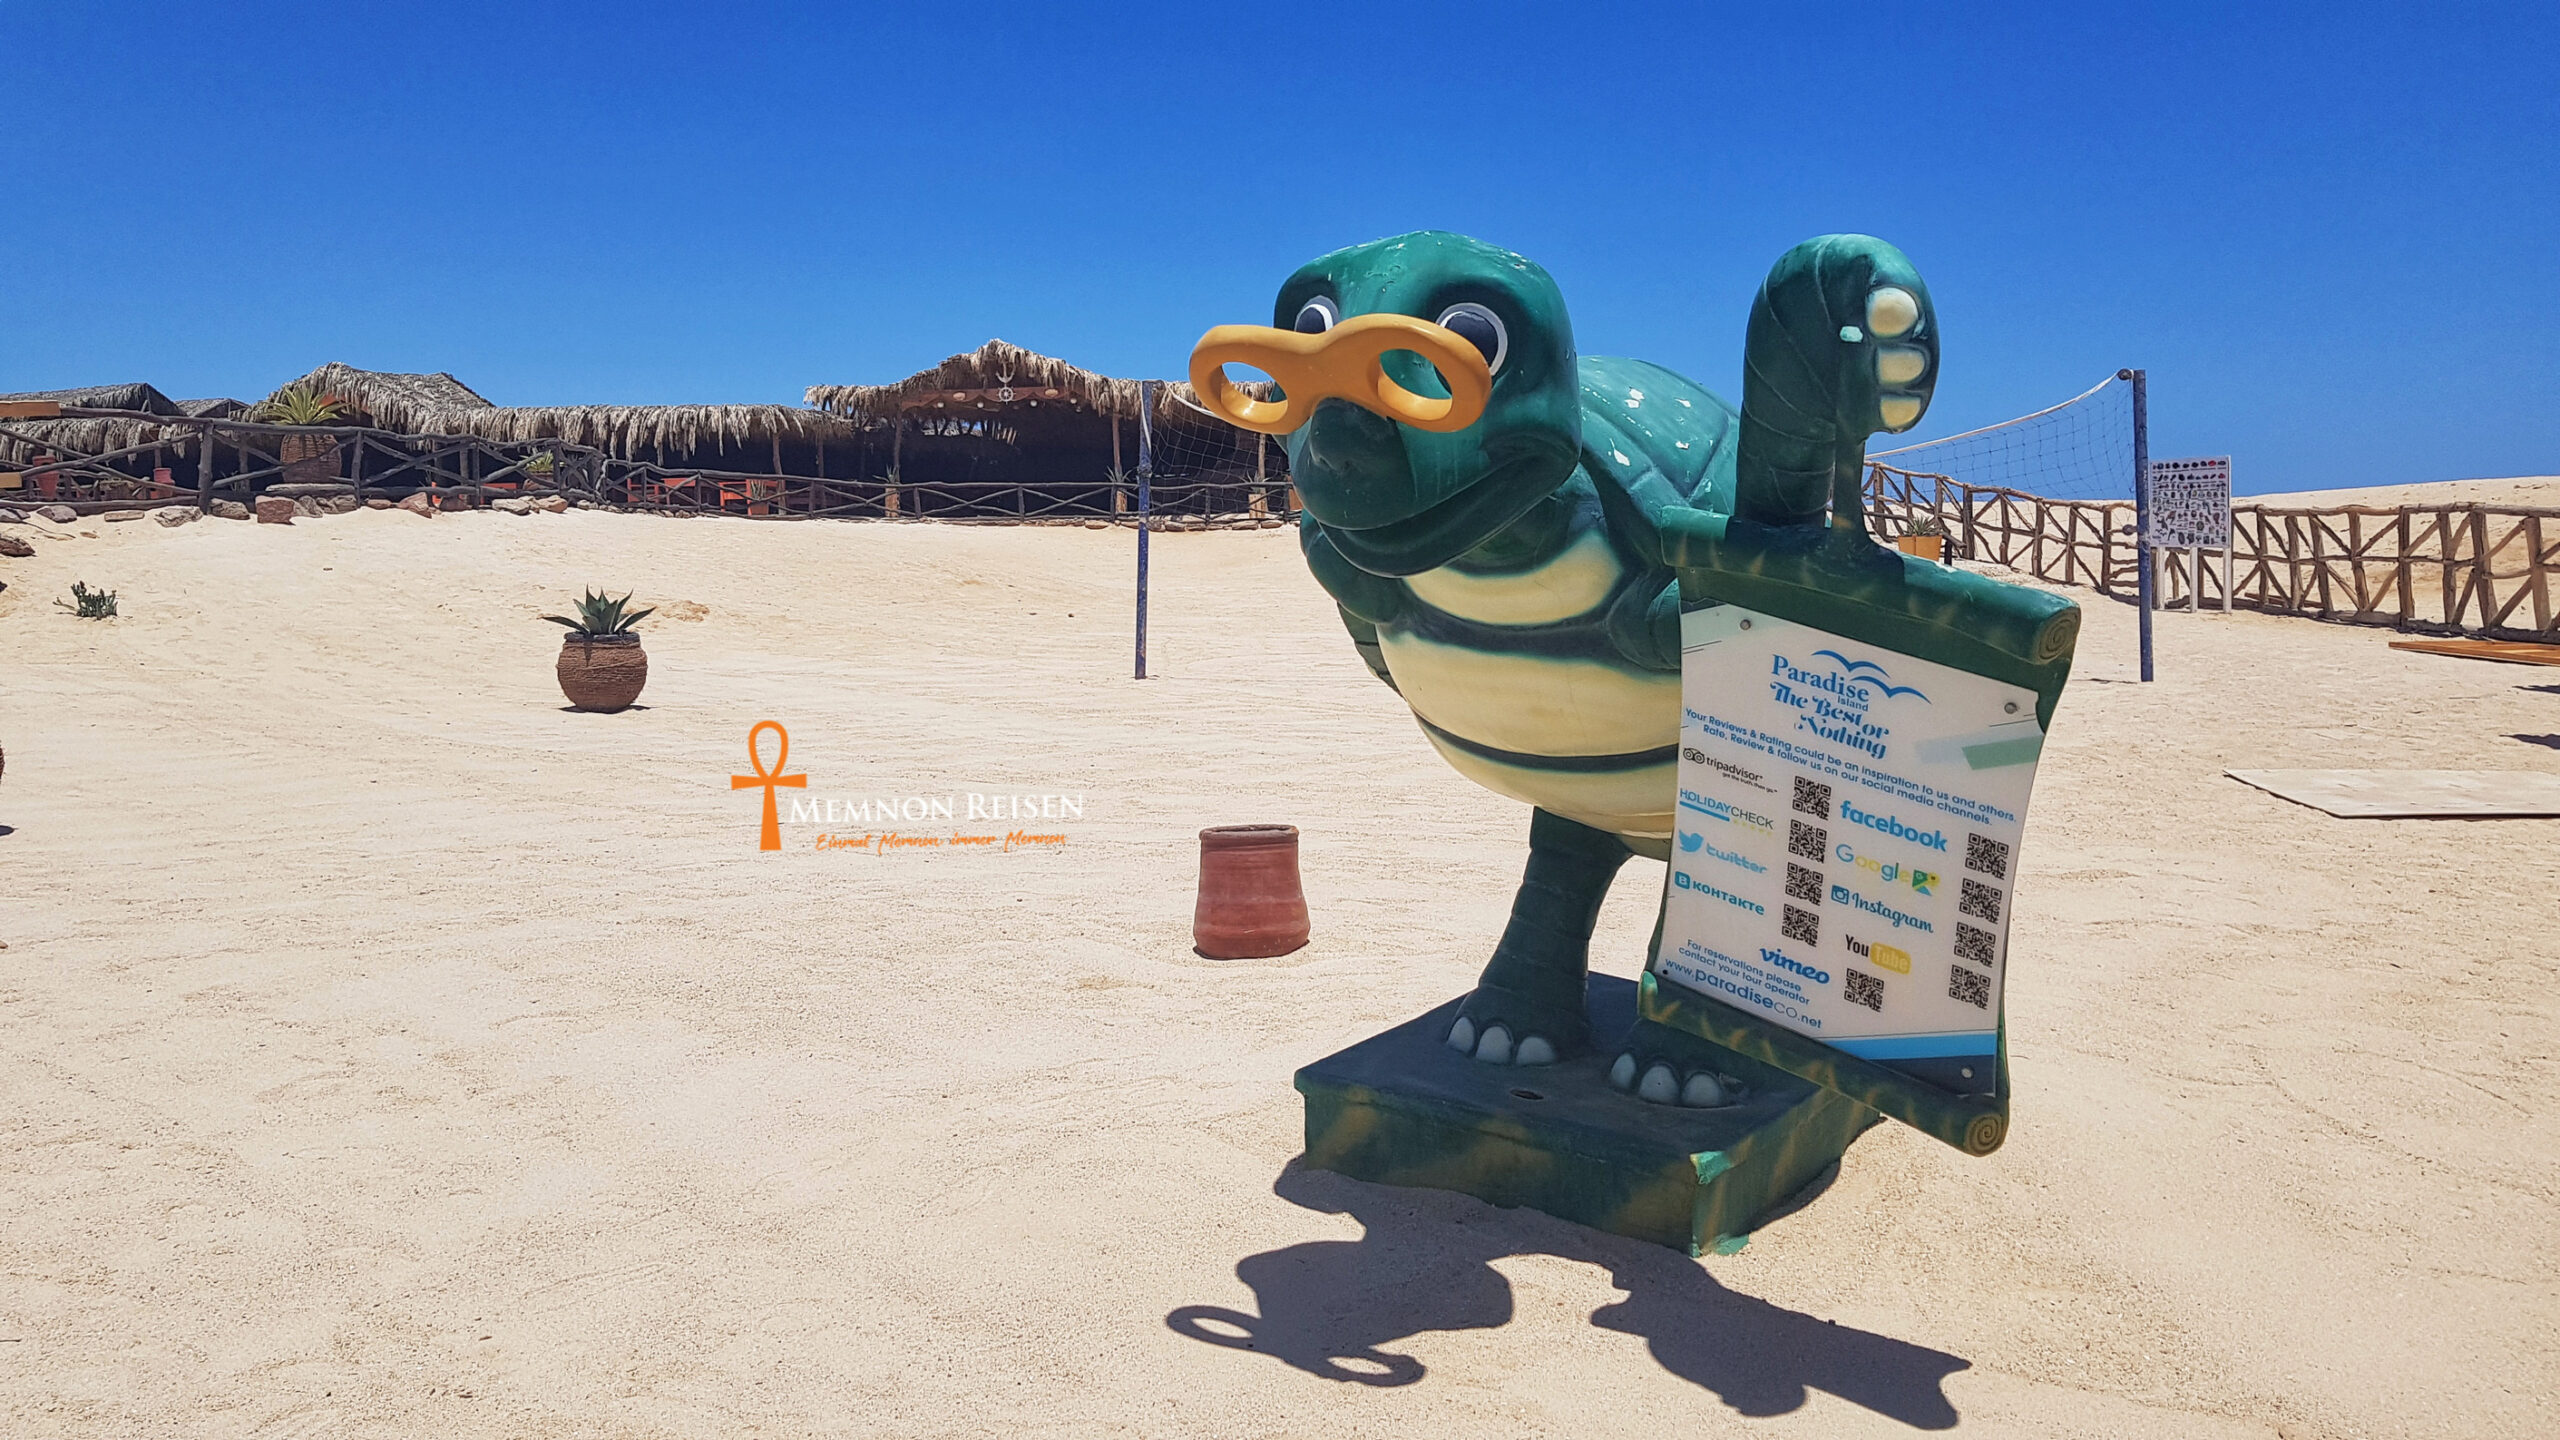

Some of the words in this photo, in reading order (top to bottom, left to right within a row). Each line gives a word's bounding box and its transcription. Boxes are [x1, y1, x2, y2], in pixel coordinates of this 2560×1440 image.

[1771, 654, 1869, 702] Paradise
[1770, 681, 1808, 708] The
[1812, 696, 1862, 726] Best
[1862, 723, 1889, 739] or
[1837, 695, 1869, 712] Island
[1795, 714, 1887, 759] Nothing
[1686, 708, 1707, 723] Your
[1709, 715, 1747, 736] Reviews
[1750, 729, 1757, 738] &
[1760, 732, 1792, 751] Rating
[1794, 746, 1824, 761] could
[1828, 754, 1841, 766] be
[1845, 762, 1859, 772] an
[1862, 765, 1919, 791] inspiration
[1922, 784, 1933, 795] to
[1936, 789, 1949, 800] us
[1952, 794, 1975, 809] and
[1978, 802, 2017, 822] others.
[1731, 733, 1765, 751] Review
[1767, 745, 1774, 754] &
[1777, 749, 1808, 766] follow
[1810, 761, 1822, 771] us
[1824, 765, 1838, 776] on
[1841, 771, 1859, 782] our
[1861, 776, 1894, 794] social
[1896, 789, 1934, 807] media
[1937, 801, 1992, 825] channels.
[1840, 800, 1948, 852] facebook
[1706, 842, 1768, 875] twitter
[1836, 844, 1911, 882] Google
[1852, 892, 1934, 934] Instagram
[1678, 947, 1716, 966] contact
[1718, 963, 1740, 977] your
[1742, 972, 1762, 986] tour
[1764, 982, 1810, 1005] operator
[1687, 939, 1702, 951] For
[1704, 947, 1764, 977] reservations
[1766, 972, 1802, 992] please
[1759, 948, 1830, 984] vimeo
[1665, 958, 1822, 1029] www.paradiseCO.net
